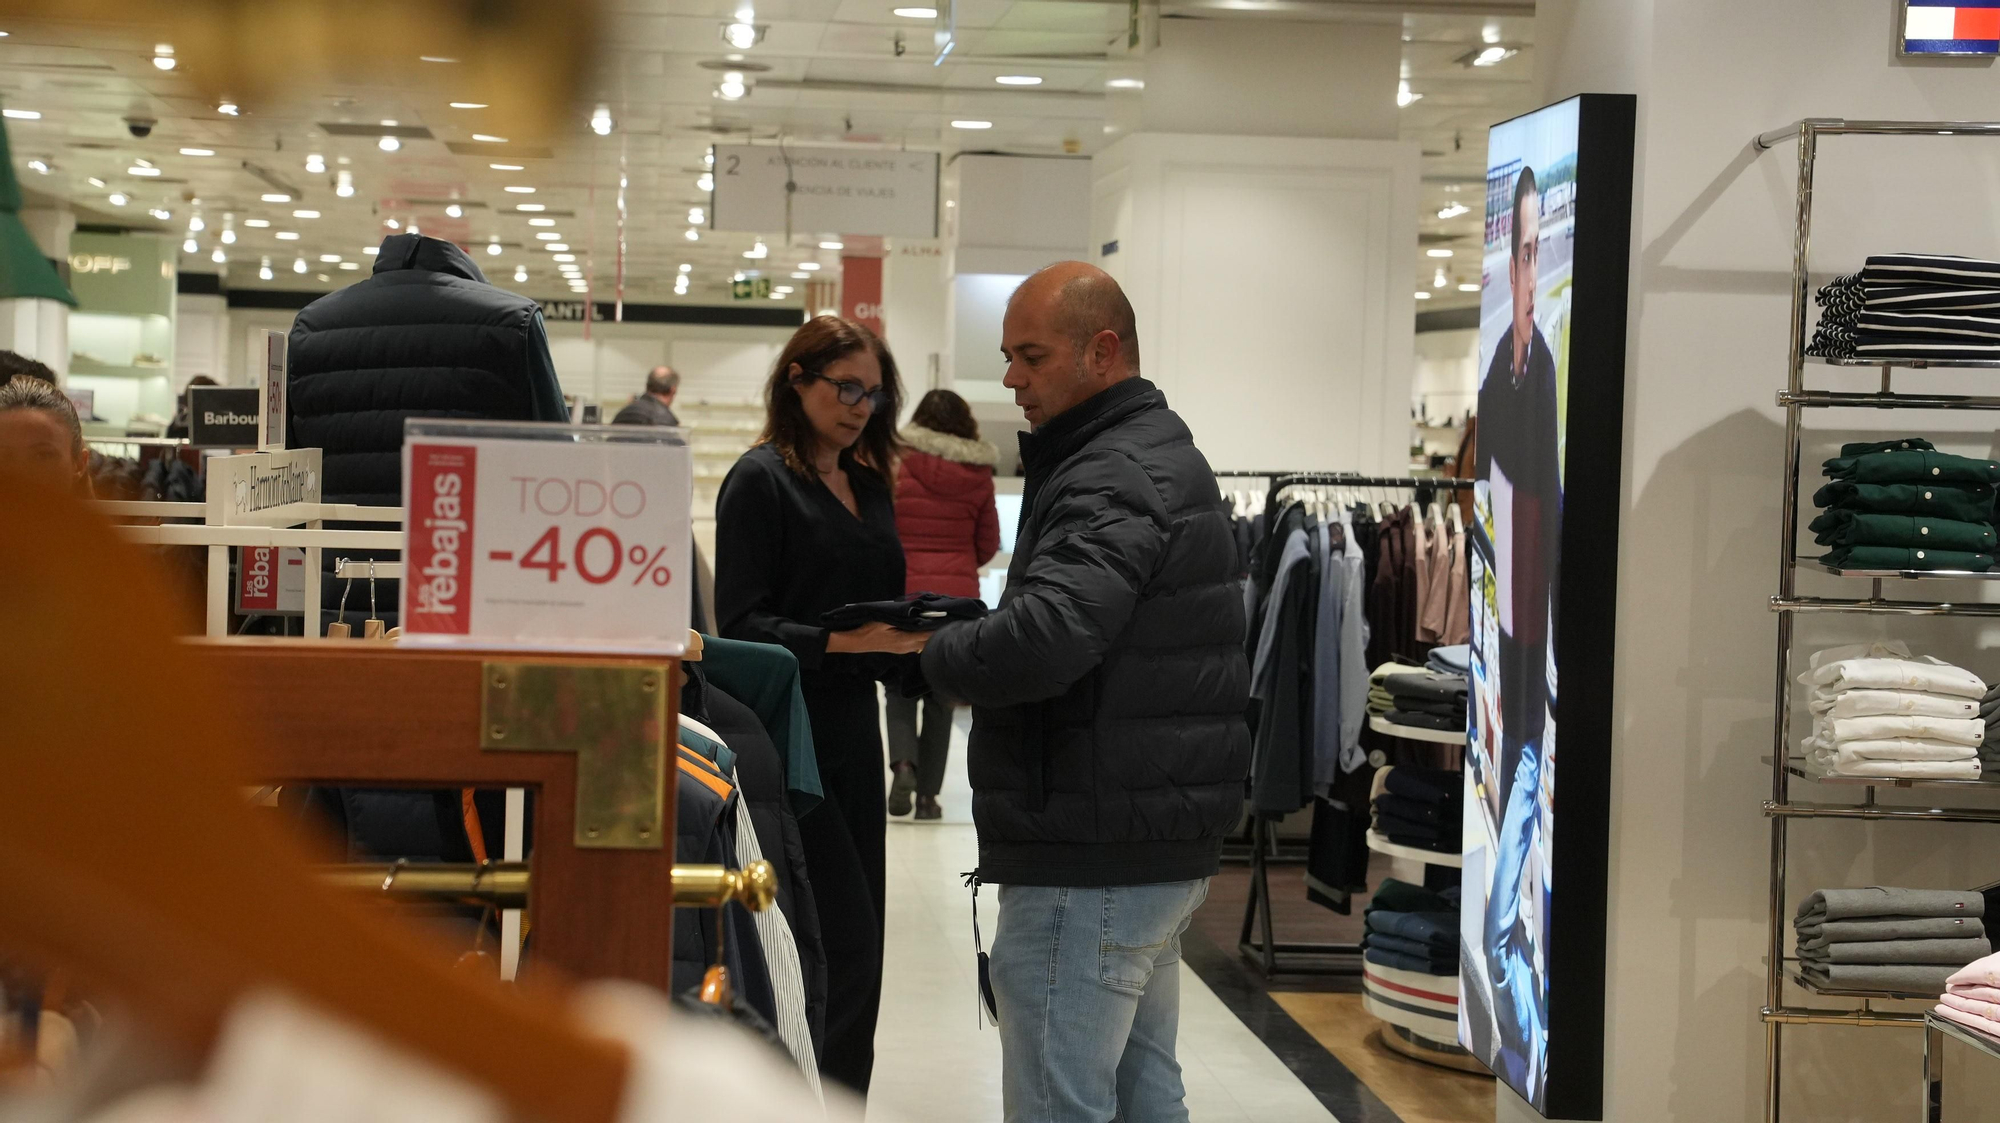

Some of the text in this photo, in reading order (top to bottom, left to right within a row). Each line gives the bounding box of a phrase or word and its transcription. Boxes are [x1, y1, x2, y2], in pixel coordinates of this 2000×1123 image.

[726, 154, 741, 176] 2
[830, 159, 845, 169] AL
[848, 158, 896, 172] CLIENTE
[836, 186, 852, 198] DE
[856, 187, 896, 199] VIAJES
[68, 253, 131, 274] OFF
[510, 476, 647, 520] TODO
[423, 472, 467, 614] rebajas
[488, 525, 672, 587] -40%
[249, 547, 270, 597] reba
[244, 580, 254, 597] Las
